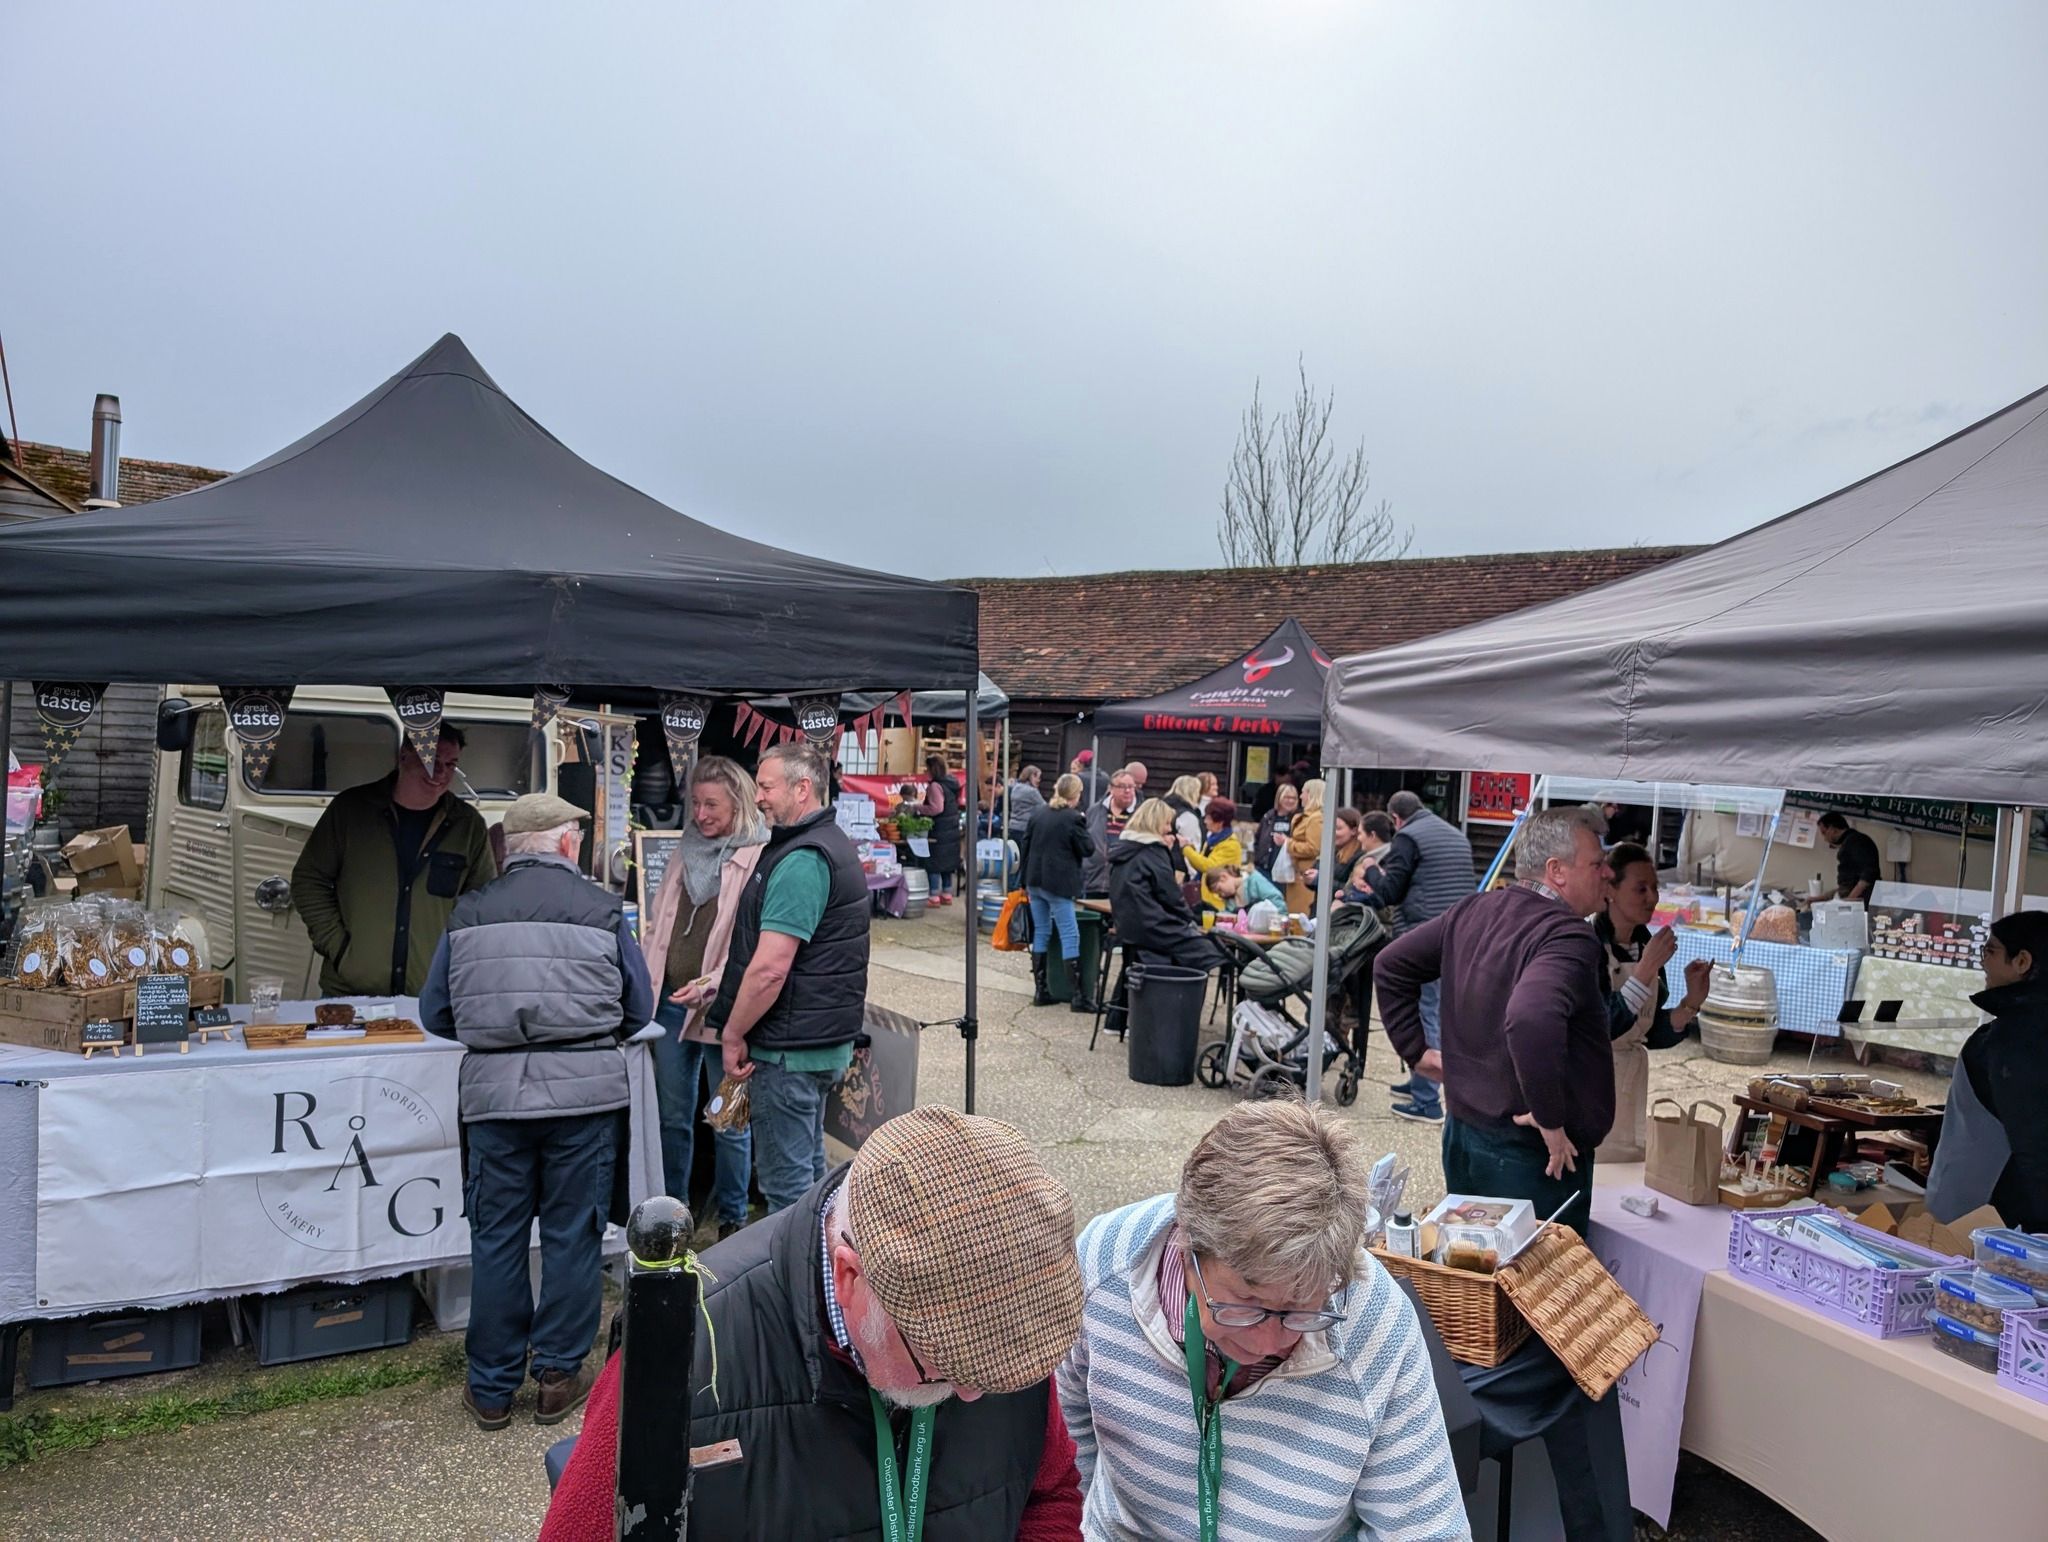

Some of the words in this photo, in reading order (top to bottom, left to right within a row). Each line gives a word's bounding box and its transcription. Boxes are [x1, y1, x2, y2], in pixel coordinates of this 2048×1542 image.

[52, 685, 81, 698] great
[406, 693, 429, 705] great
[40, 692, 92, 713] taste
[243, 704, 269, 714] great
[398, 700, 441, 717] taste
[233, 711, 280, 726] taste
[673, 708, 694, 717] great
[807, 709, 826, 719] great
[665, 714, 702, 730] taste
[801, 716, 835, 730] taste
[1143, 713, 1210, 732] Biltong
[1213, 715, 1226, 732] &
[1228, 716, 1283, 736] Jerky
[1476, 776, 1516, 794] THE
[1469, 793, 1525, 811] GULP
[1809, 791, 1864, 804] OLIVES
[1870, 796, 1881, 808] &
[1888, 797, 1991, 827] FETACHESE
[380, 1086, 429, 1125] NORDIC
[277, 1201, 326, 1239] BAKERY
[884, 1457, 895, 1511] Chichester
[906, 1421, 927, 1542] rdistrict.foodbank.org.uk
